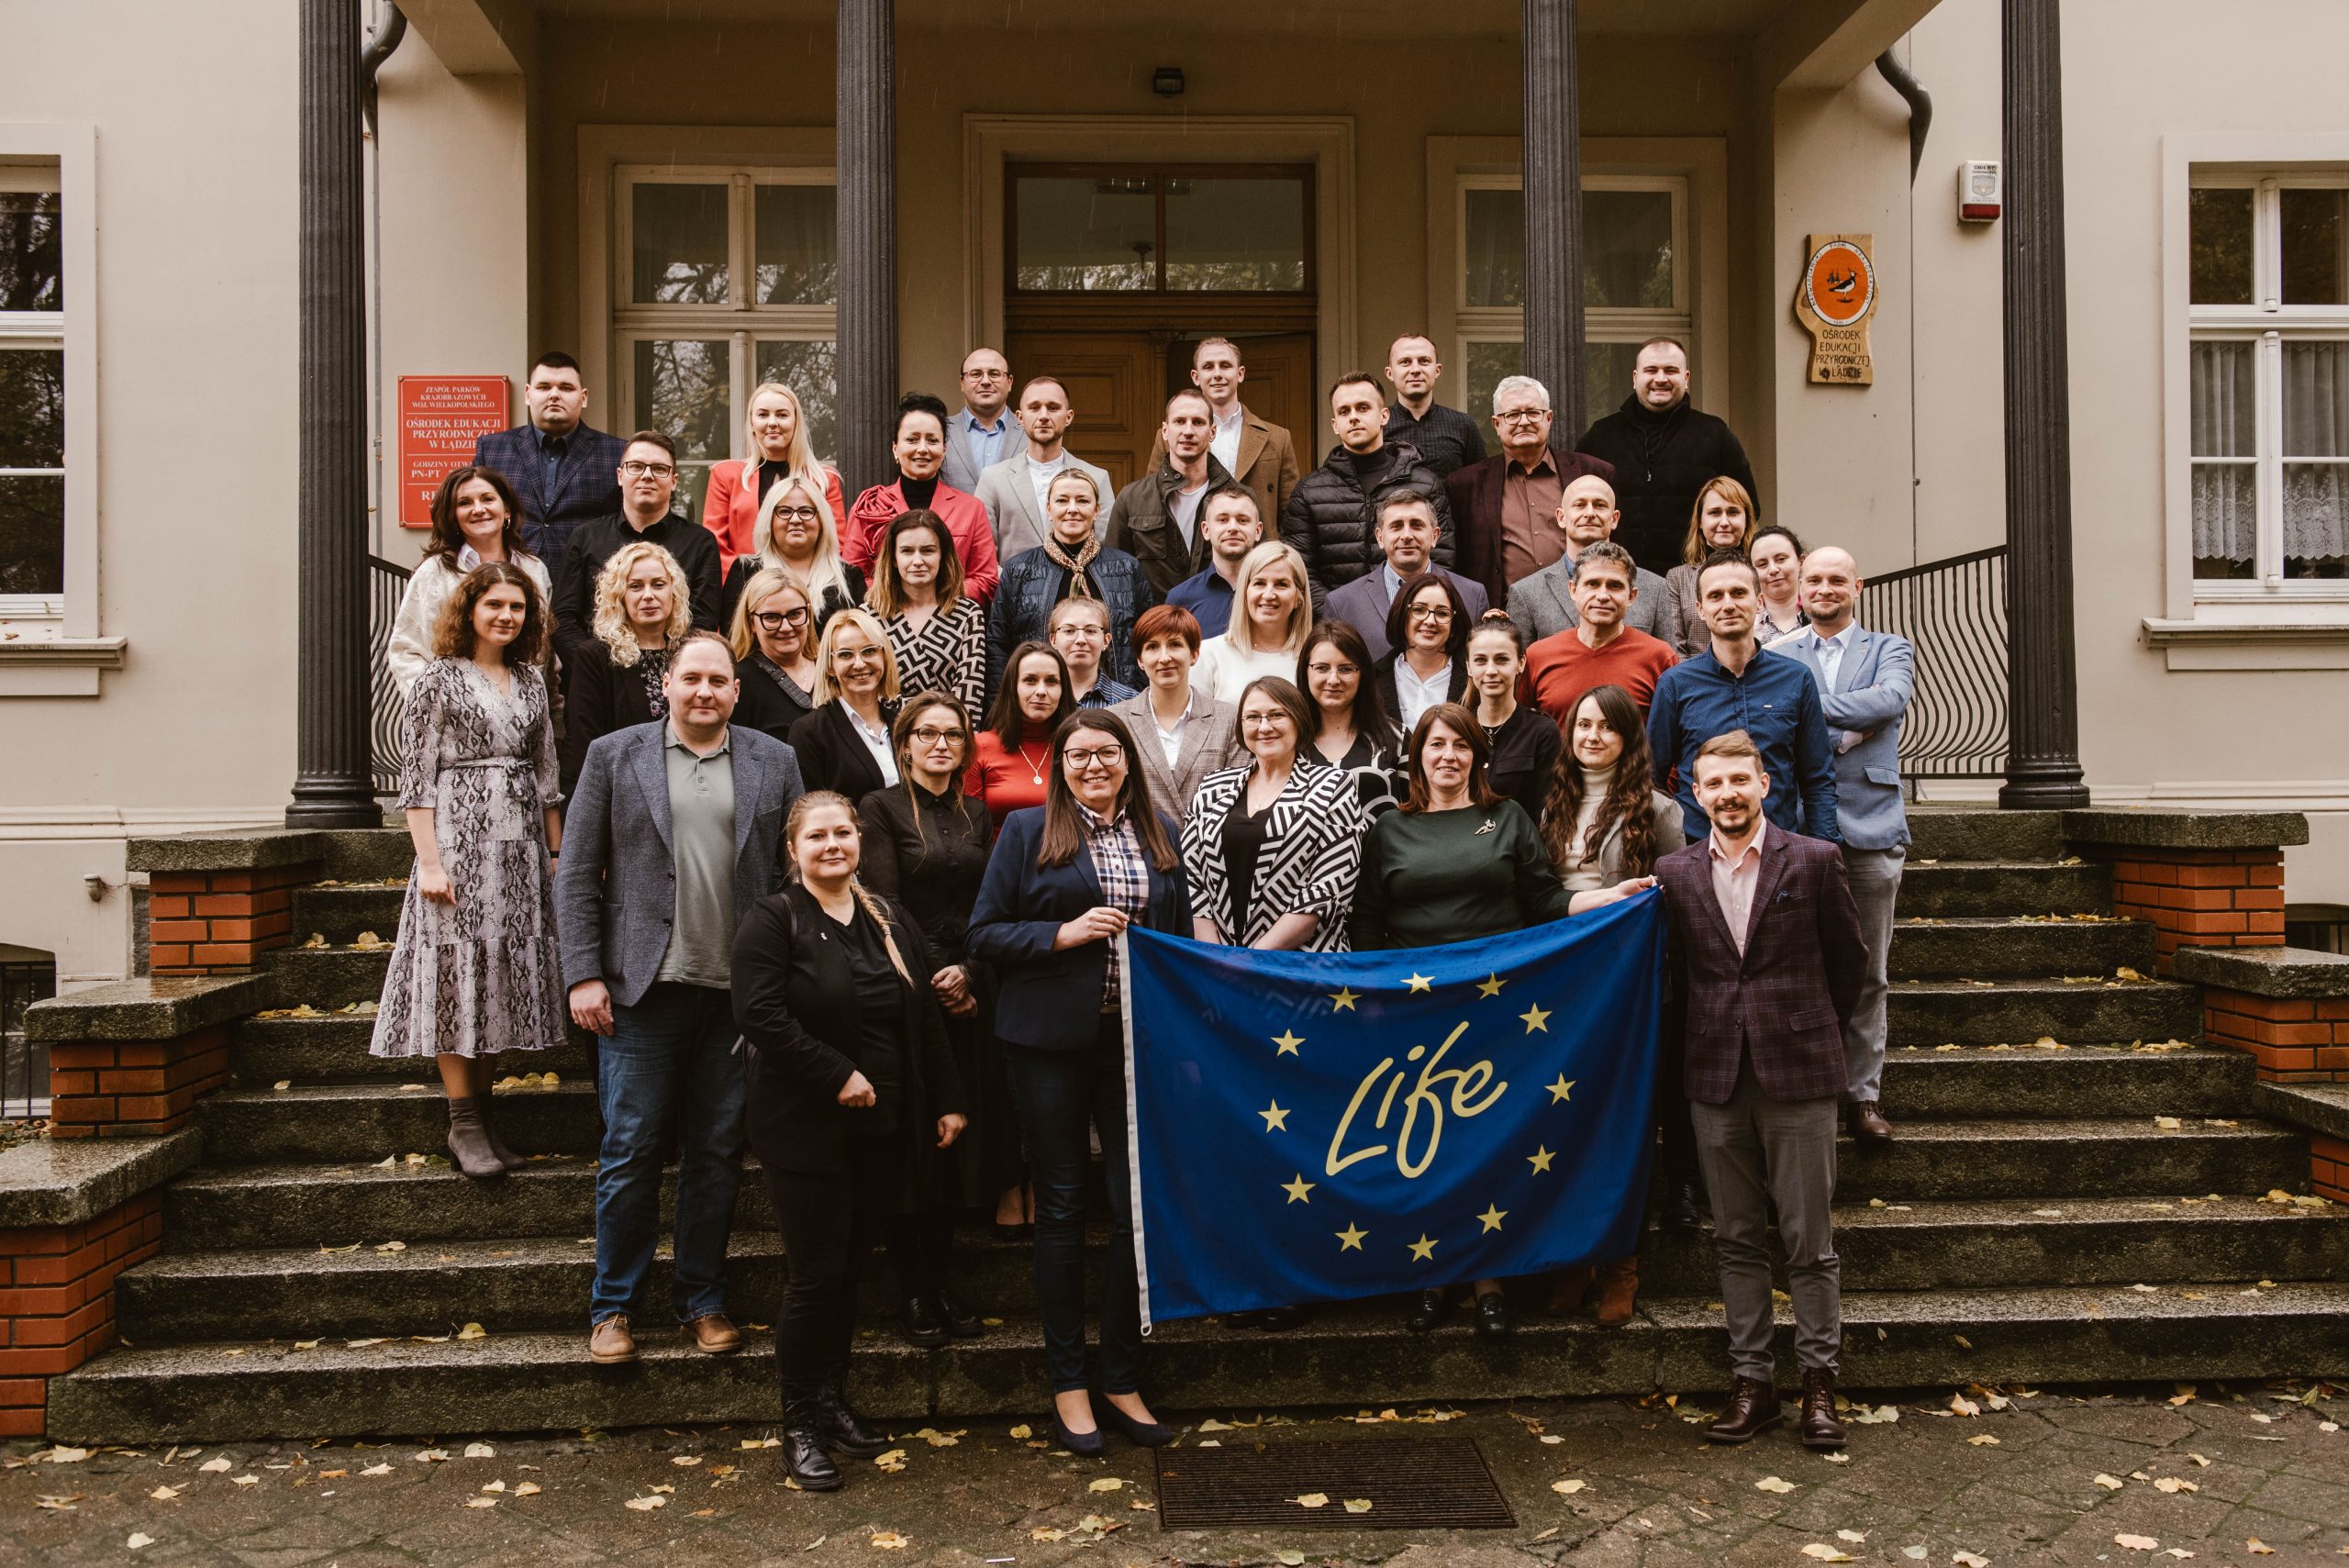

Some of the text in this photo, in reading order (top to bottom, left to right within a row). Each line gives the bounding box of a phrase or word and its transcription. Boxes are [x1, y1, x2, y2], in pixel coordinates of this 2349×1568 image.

[1822, 328, 1861, 339] OŚRODEK
[1820, 342, 1861, 354] EDUKACJI
[1816, 354, 1870, 367] PRZYRODNICZEJ
[1831, 367, 1863, 379] LĄDZIE
[406, 417, 501, 428] OŚRODEK EDUKACJI
[429, 440, 477, 450] W LĄDZIE
[1326, 1021, 1508, 1178] Life
